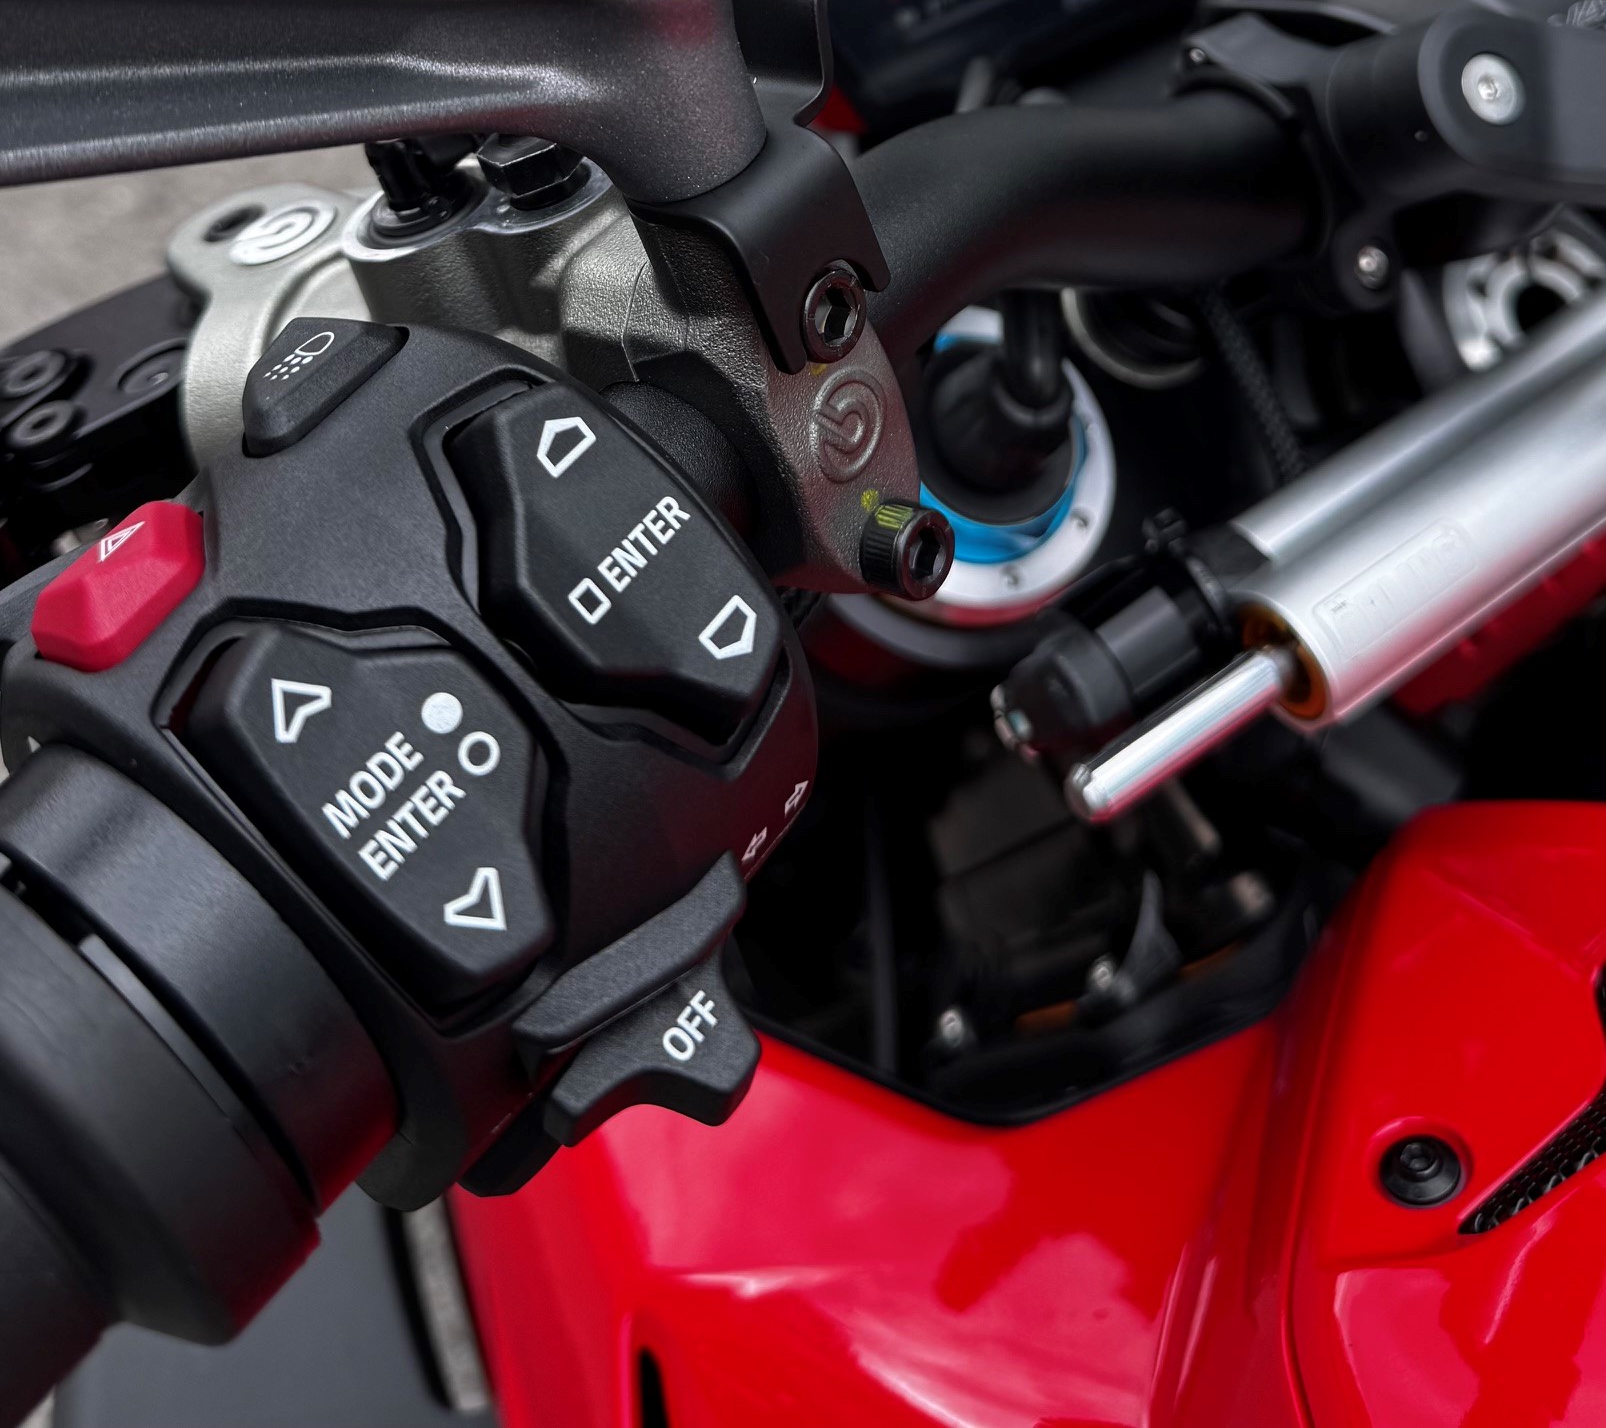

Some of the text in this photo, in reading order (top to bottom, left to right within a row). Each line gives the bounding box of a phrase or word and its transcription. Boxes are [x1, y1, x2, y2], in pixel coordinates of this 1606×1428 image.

[596, 495, 692, 593] ENTER
[321, 731, 424, 839] MODE
[357, 770, 467, 881] ENTER
[661, 989, 718, 1062] OFF
